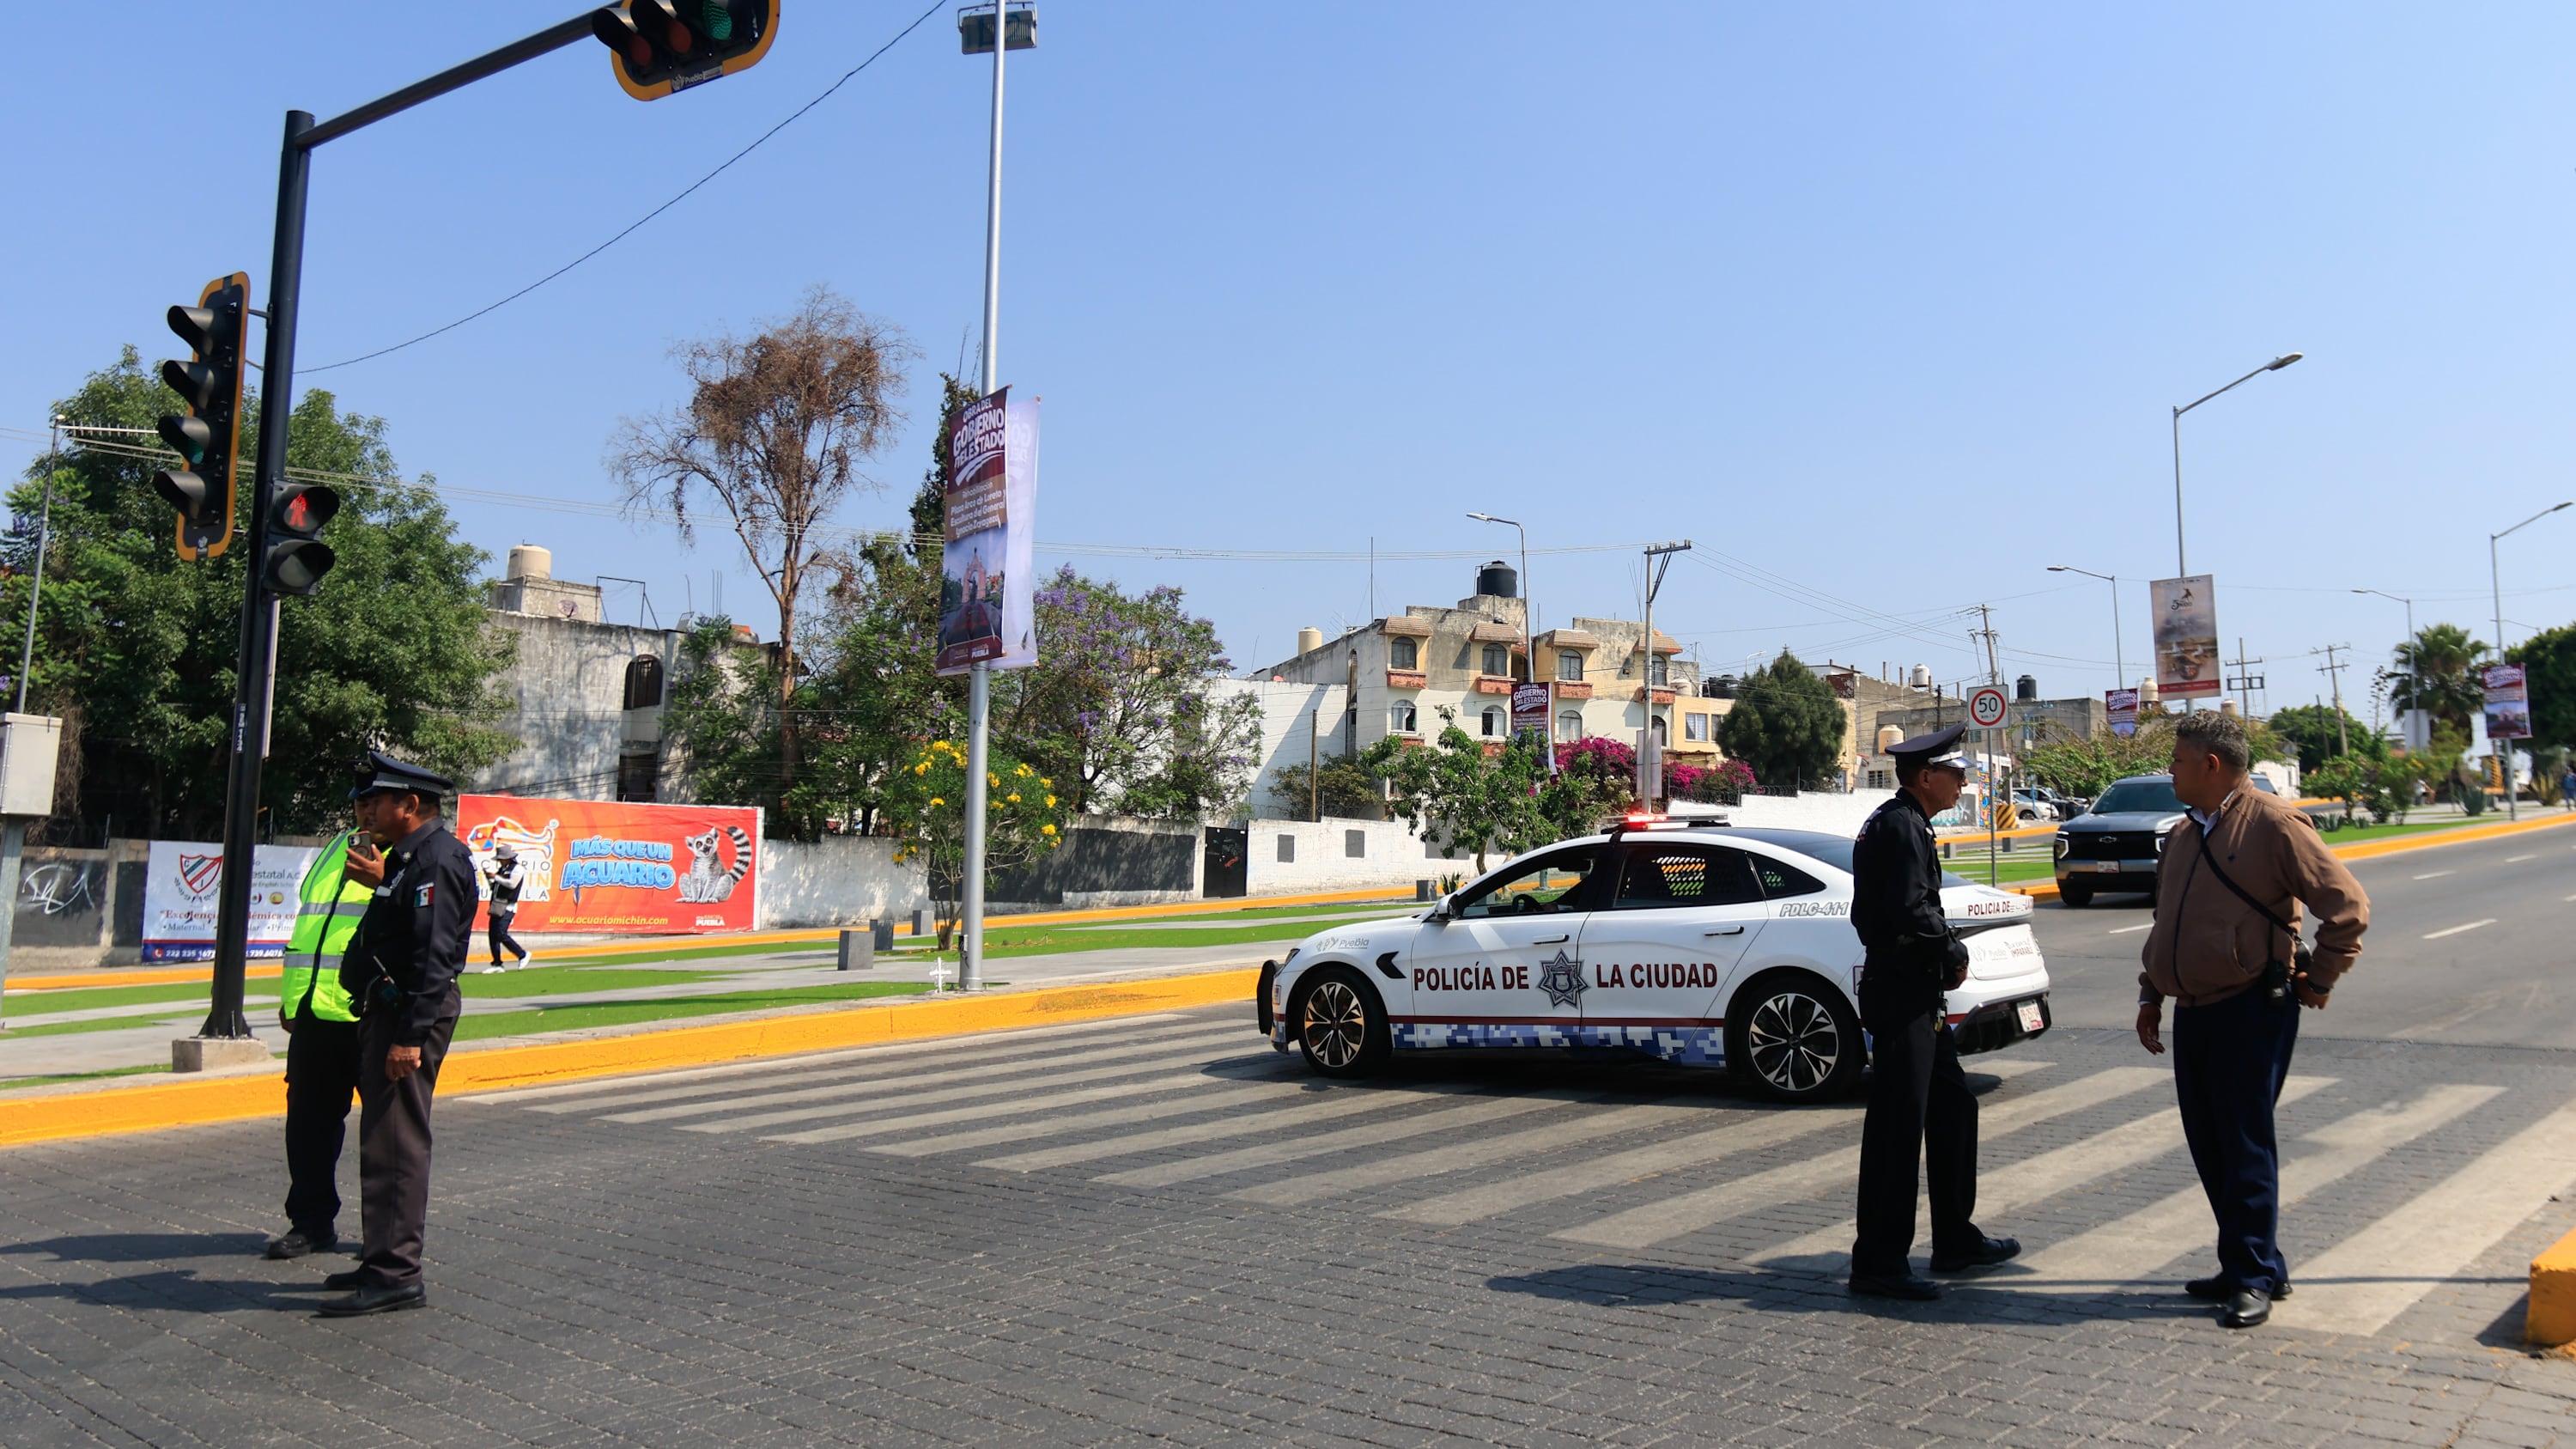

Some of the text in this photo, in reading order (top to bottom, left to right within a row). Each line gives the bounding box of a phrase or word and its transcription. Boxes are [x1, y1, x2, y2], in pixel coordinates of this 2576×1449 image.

[963, 398, 993, 423] OBRA DEL
[953, 408, 1005, 457] GOBIERNO
[968, 429, 1005, 459] ESTADO
[1513, 689, 1547, 701] GOBIERNO
[1523, 696, 1547, 704] ESTADO
[1978, 697, 1998, 713] 50
[570, 835, 672, 862] MÁS QUE UN
[560, 860, 676, 891] ACUARIO
[1779, 902, 1850, 917] PDLC-411
[549, 915, 669, 926] www.acuariomichin.com
[1339, 938, 1370, 947] Puebla
[1413, 961, 1718, 991] POLICÍA DE LA CIUDAD
